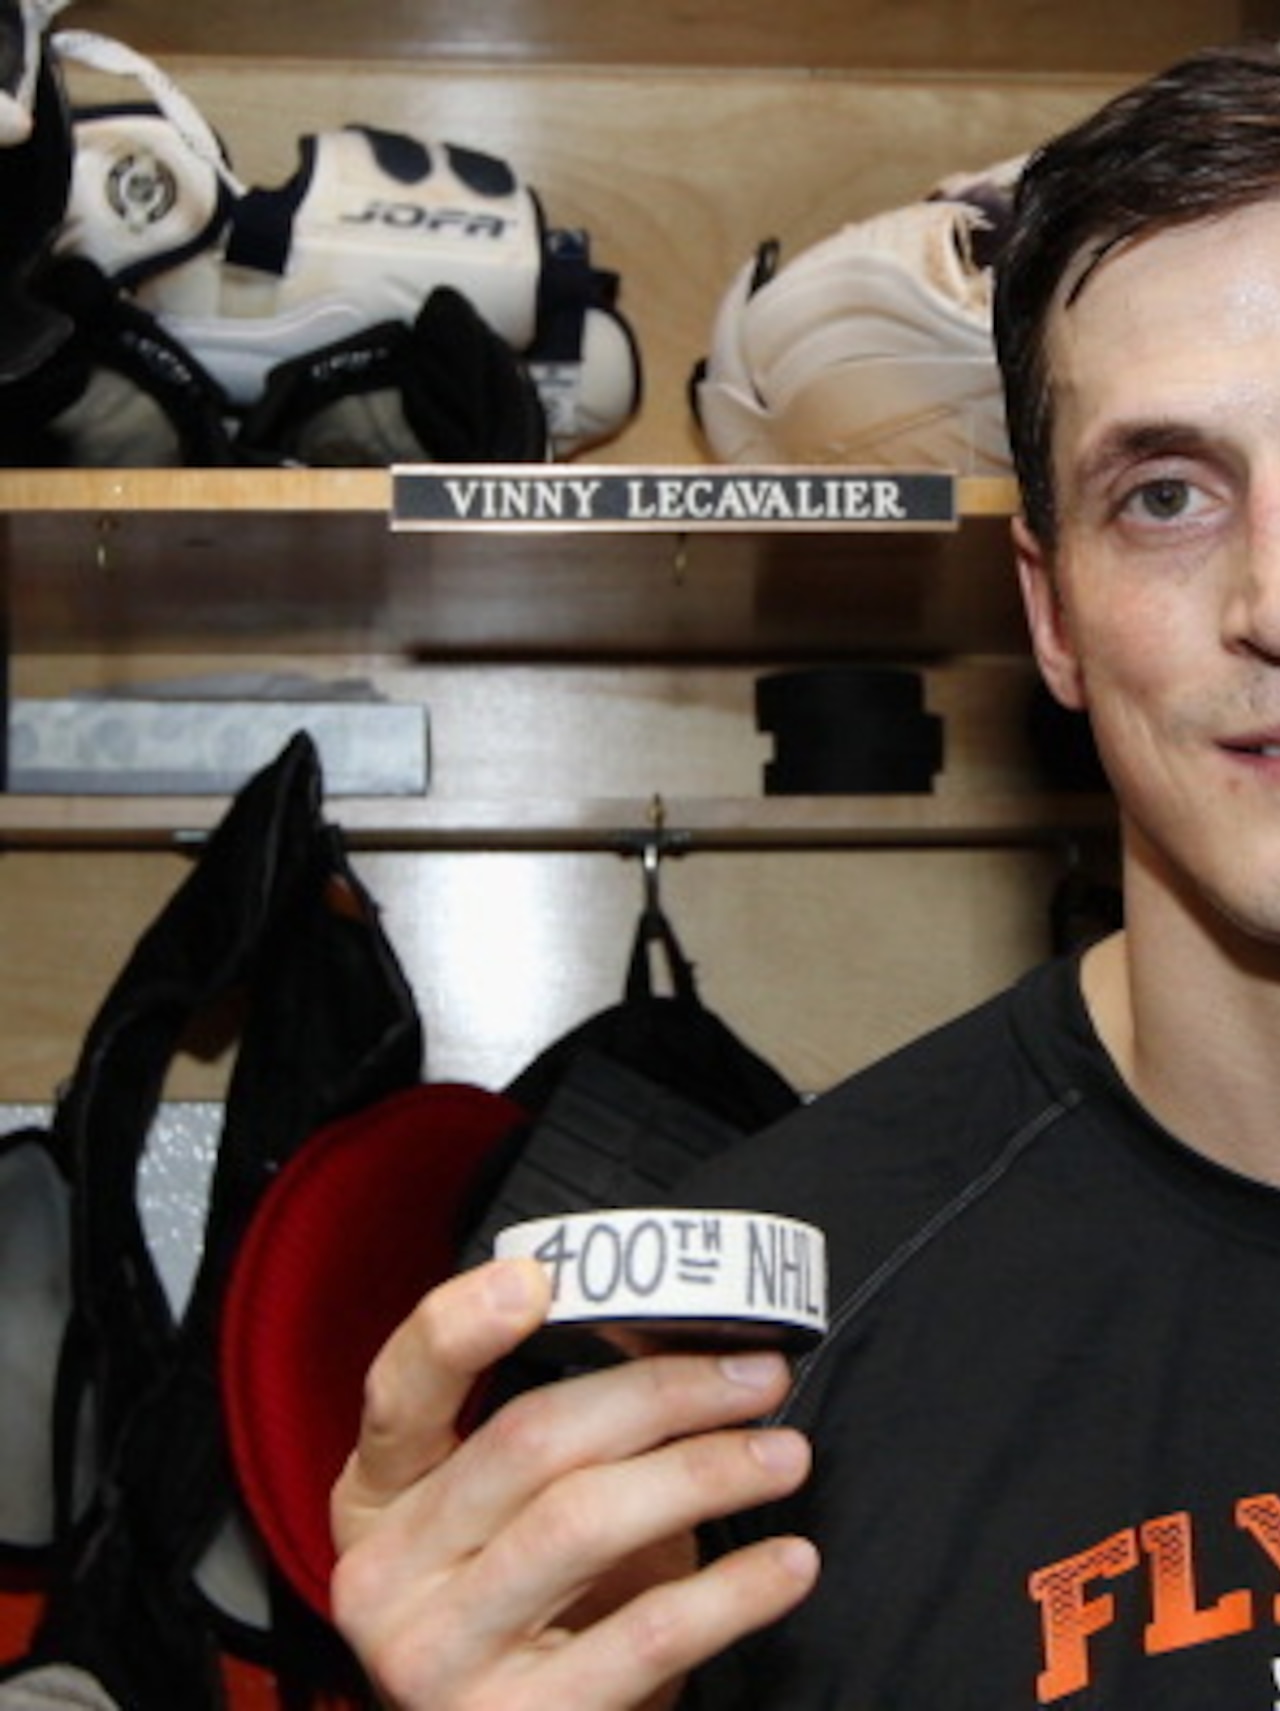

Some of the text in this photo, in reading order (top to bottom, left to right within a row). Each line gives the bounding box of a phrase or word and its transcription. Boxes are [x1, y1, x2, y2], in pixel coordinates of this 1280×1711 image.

[338, 201, 505, 238] JOFA
[445, 480, 906, 519] VINNY LECAVALIER
[746, 1219, 819, 1316] NHL
